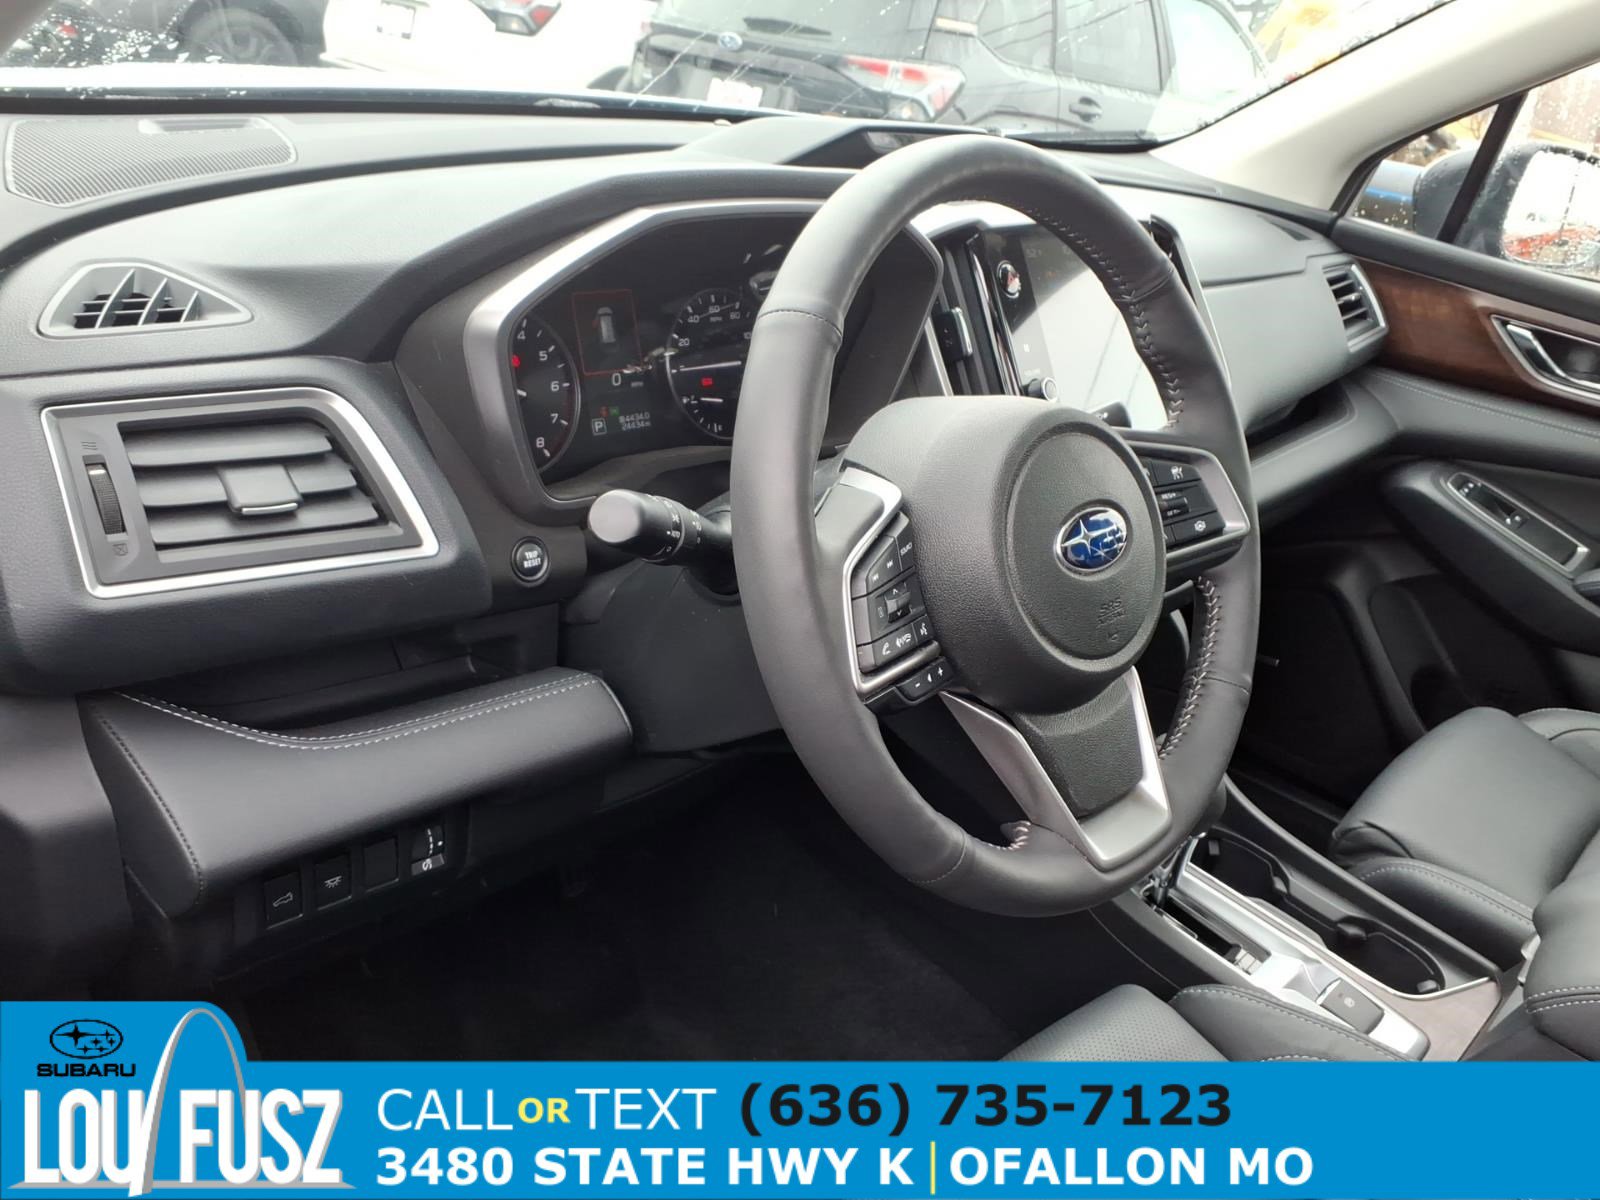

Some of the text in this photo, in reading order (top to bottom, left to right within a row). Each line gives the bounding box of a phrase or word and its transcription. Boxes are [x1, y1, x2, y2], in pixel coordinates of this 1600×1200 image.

[688, 315, 700, 323] 40
[517, 331, 526, 340] 4
[678, 337, 690, 347] 20
[539, 350, 548, 361] 5
[612, 373, 622, 387] 0
[551, 381, 560, 392] 6
[551, 413, 559, 424] 7
[536, 437, 545, 448] 8
[525, 550, 539, 560] TRIP
[523, 557, 541, 568] RESET
